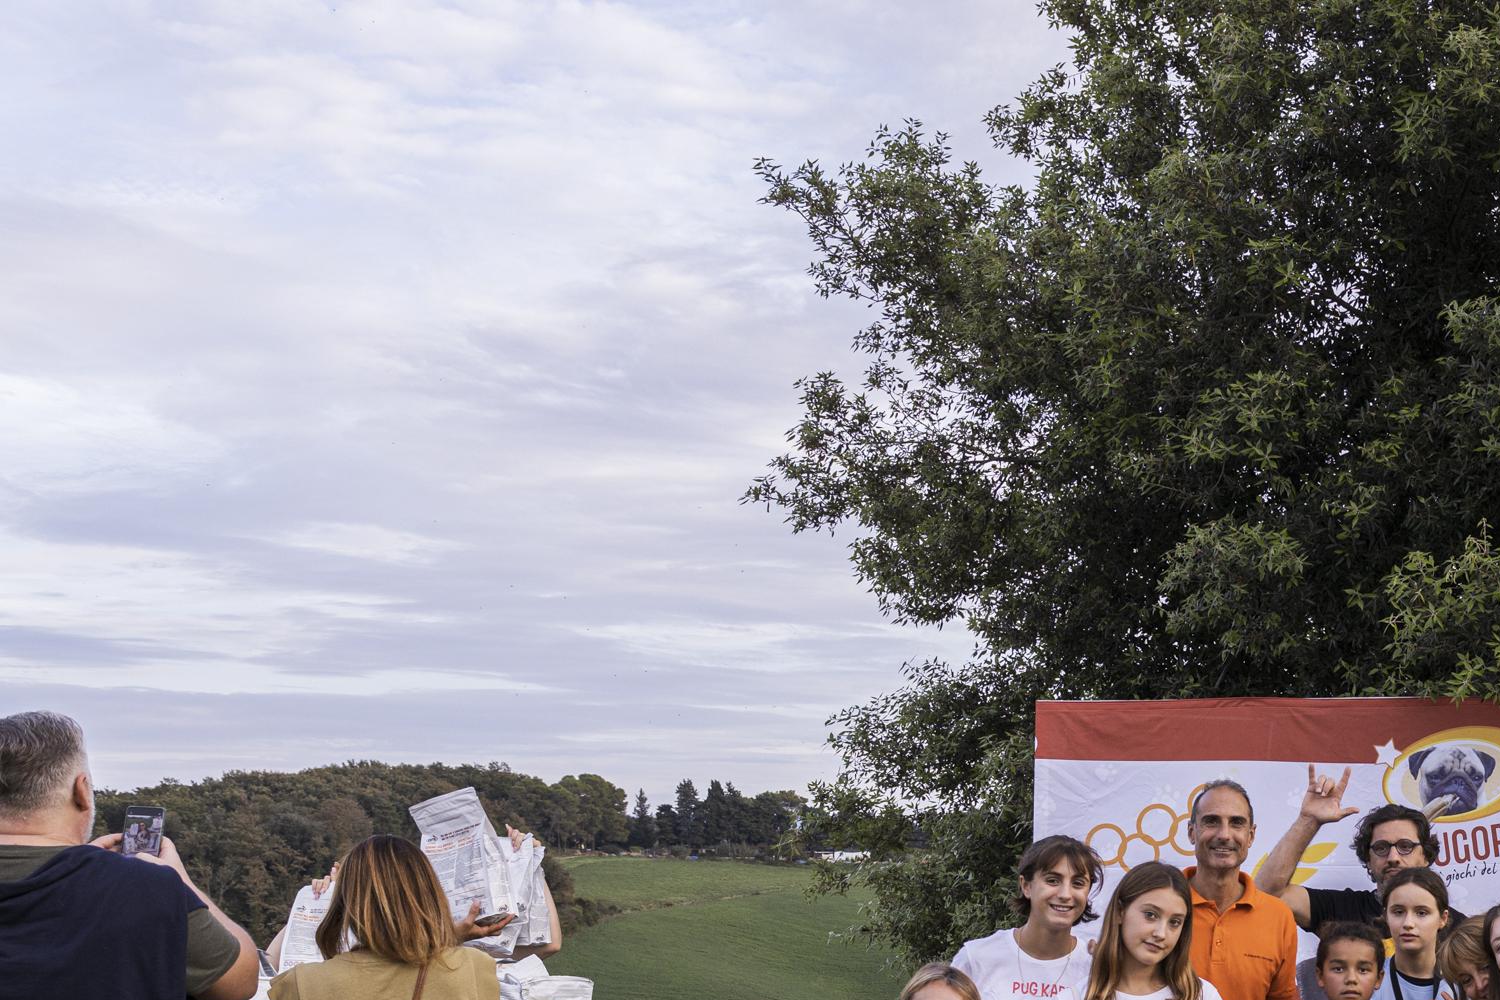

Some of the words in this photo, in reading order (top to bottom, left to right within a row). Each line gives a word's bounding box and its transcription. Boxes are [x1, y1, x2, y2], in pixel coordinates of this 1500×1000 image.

[1446, 864, 1476, 887] giochi
[1481, 861, 1497, 875] del
[1012, 981, 1038, 996] PUG
